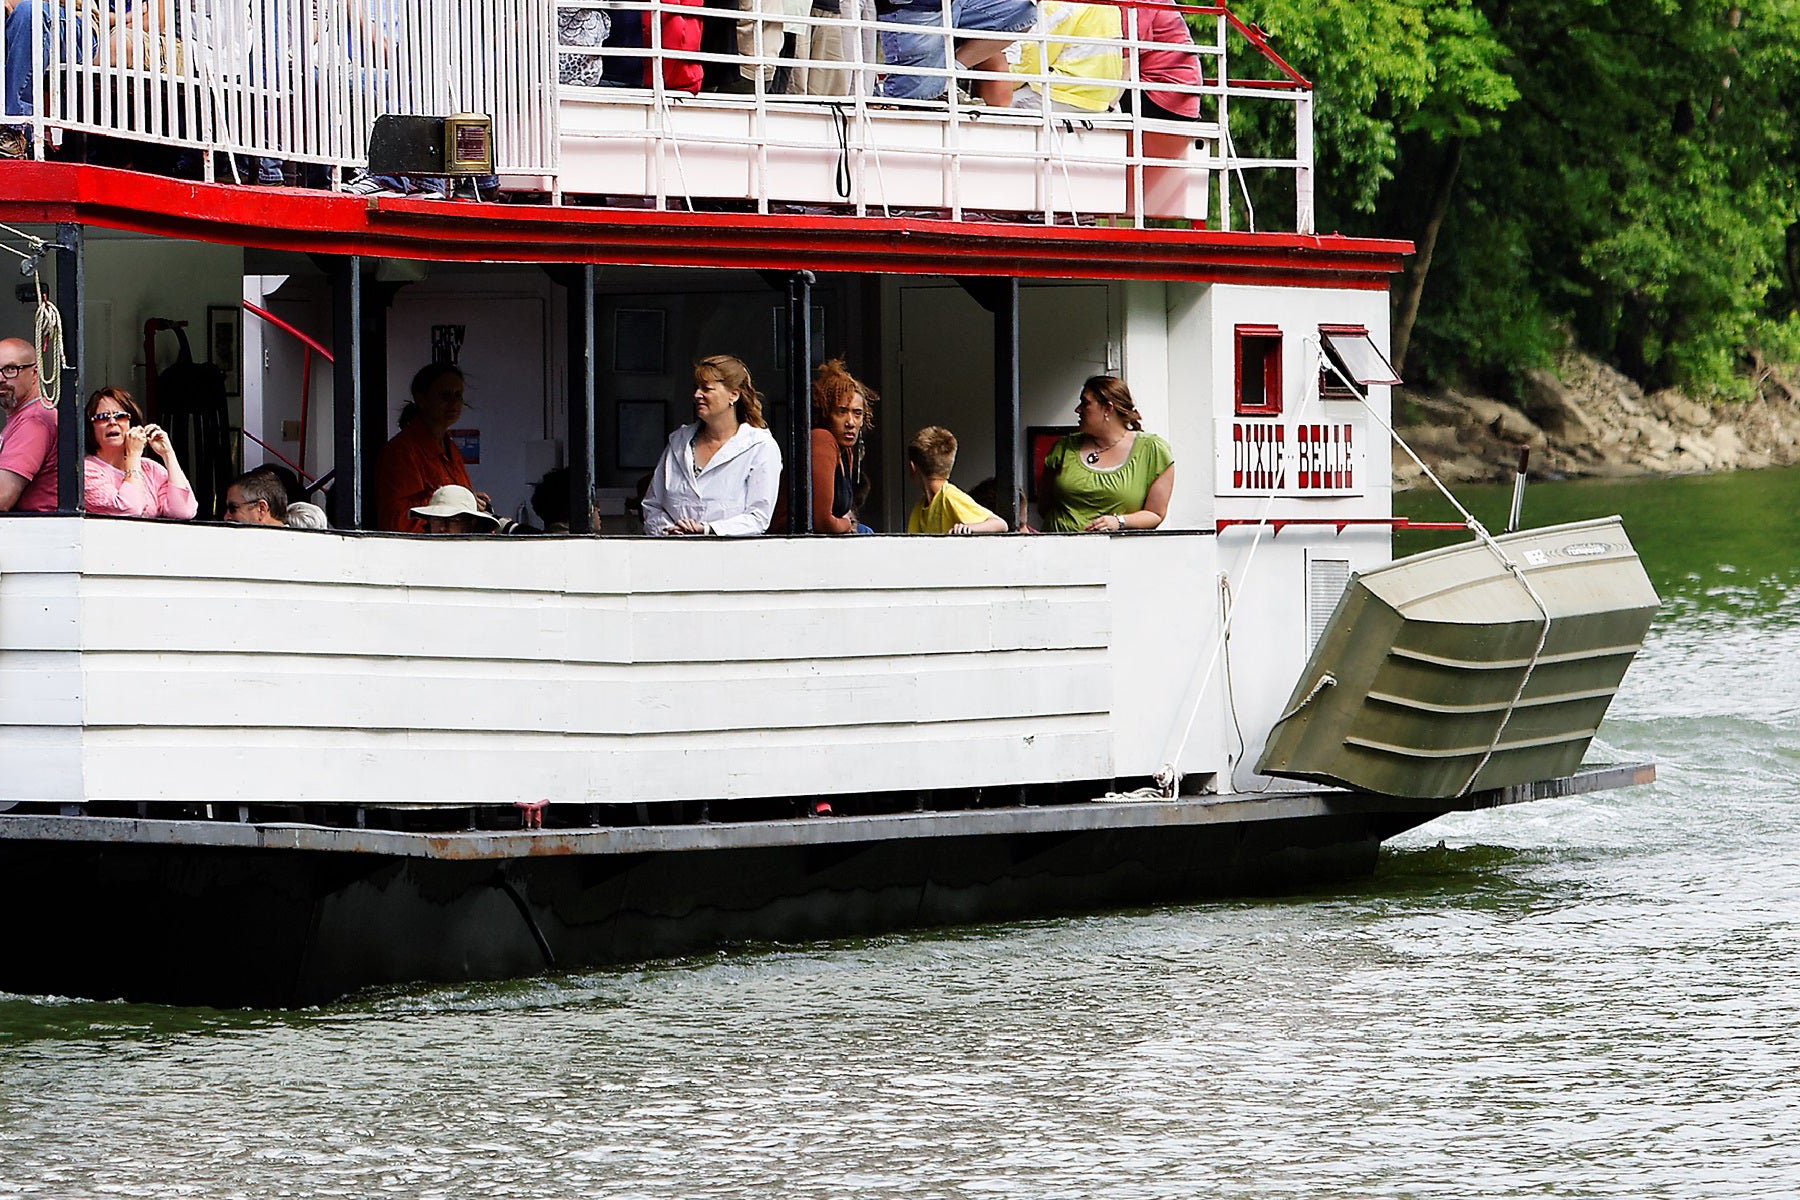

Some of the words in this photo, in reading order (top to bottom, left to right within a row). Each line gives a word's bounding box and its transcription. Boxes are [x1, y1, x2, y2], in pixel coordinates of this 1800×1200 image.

[431, 324, 467, 345] CREW
[1233, 424, 1286, 489] DIXIE
[1298, 424, 1353, 489] BELLE
